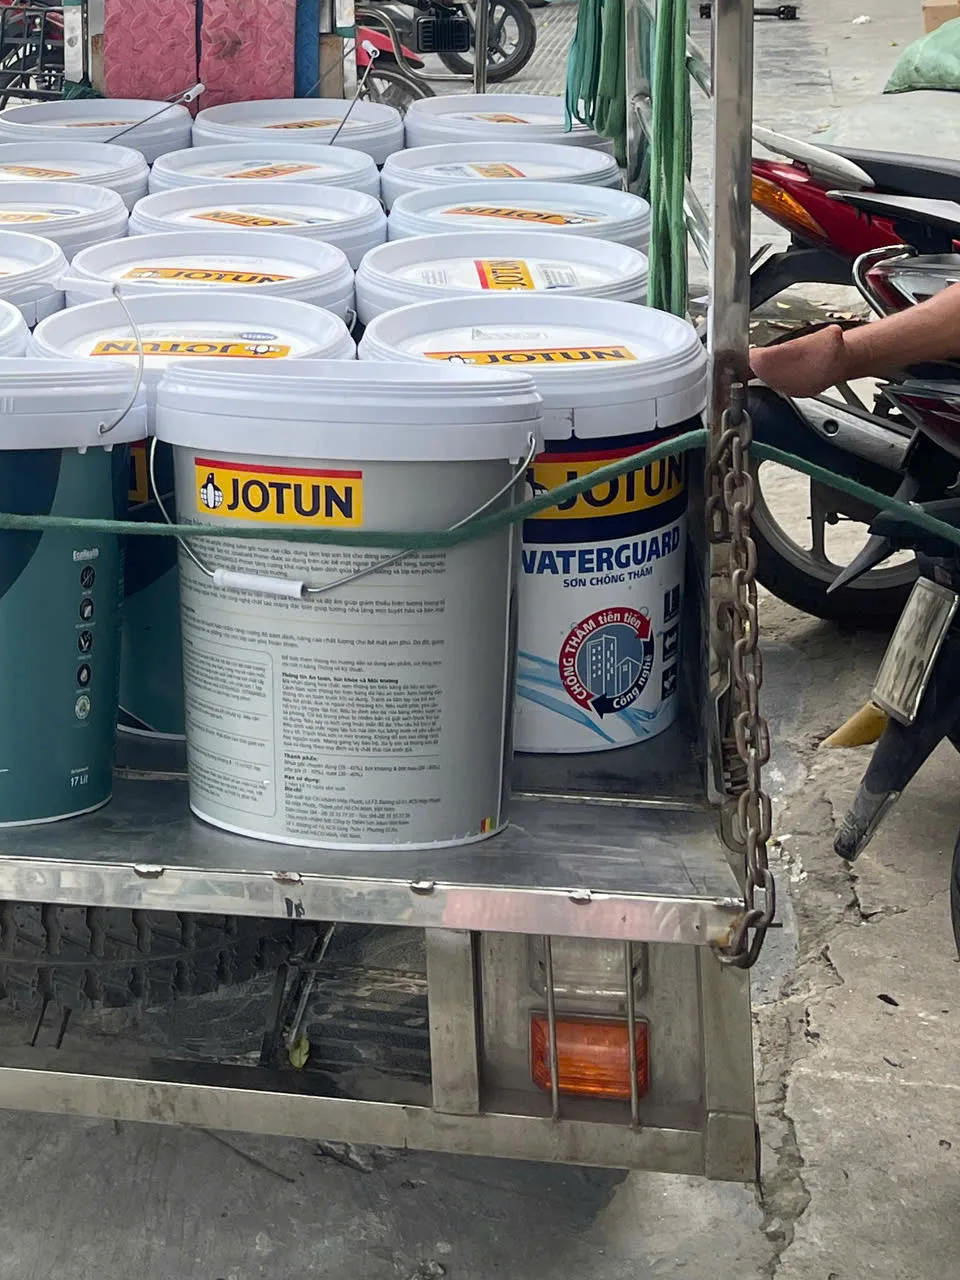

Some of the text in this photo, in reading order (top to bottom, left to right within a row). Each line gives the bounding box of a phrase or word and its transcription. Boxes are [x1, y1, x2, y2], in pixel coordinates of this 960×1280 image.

[101, 342, 238, 354] JOTUN
[486, 349, 626, 364] JOTUN
[227, 478, 353, 519] JOTUN
[563, 577, 586, 588] SƠN
[589, 571, 625, 586] CHỐNG
[612, 687, 640, 709] Công
